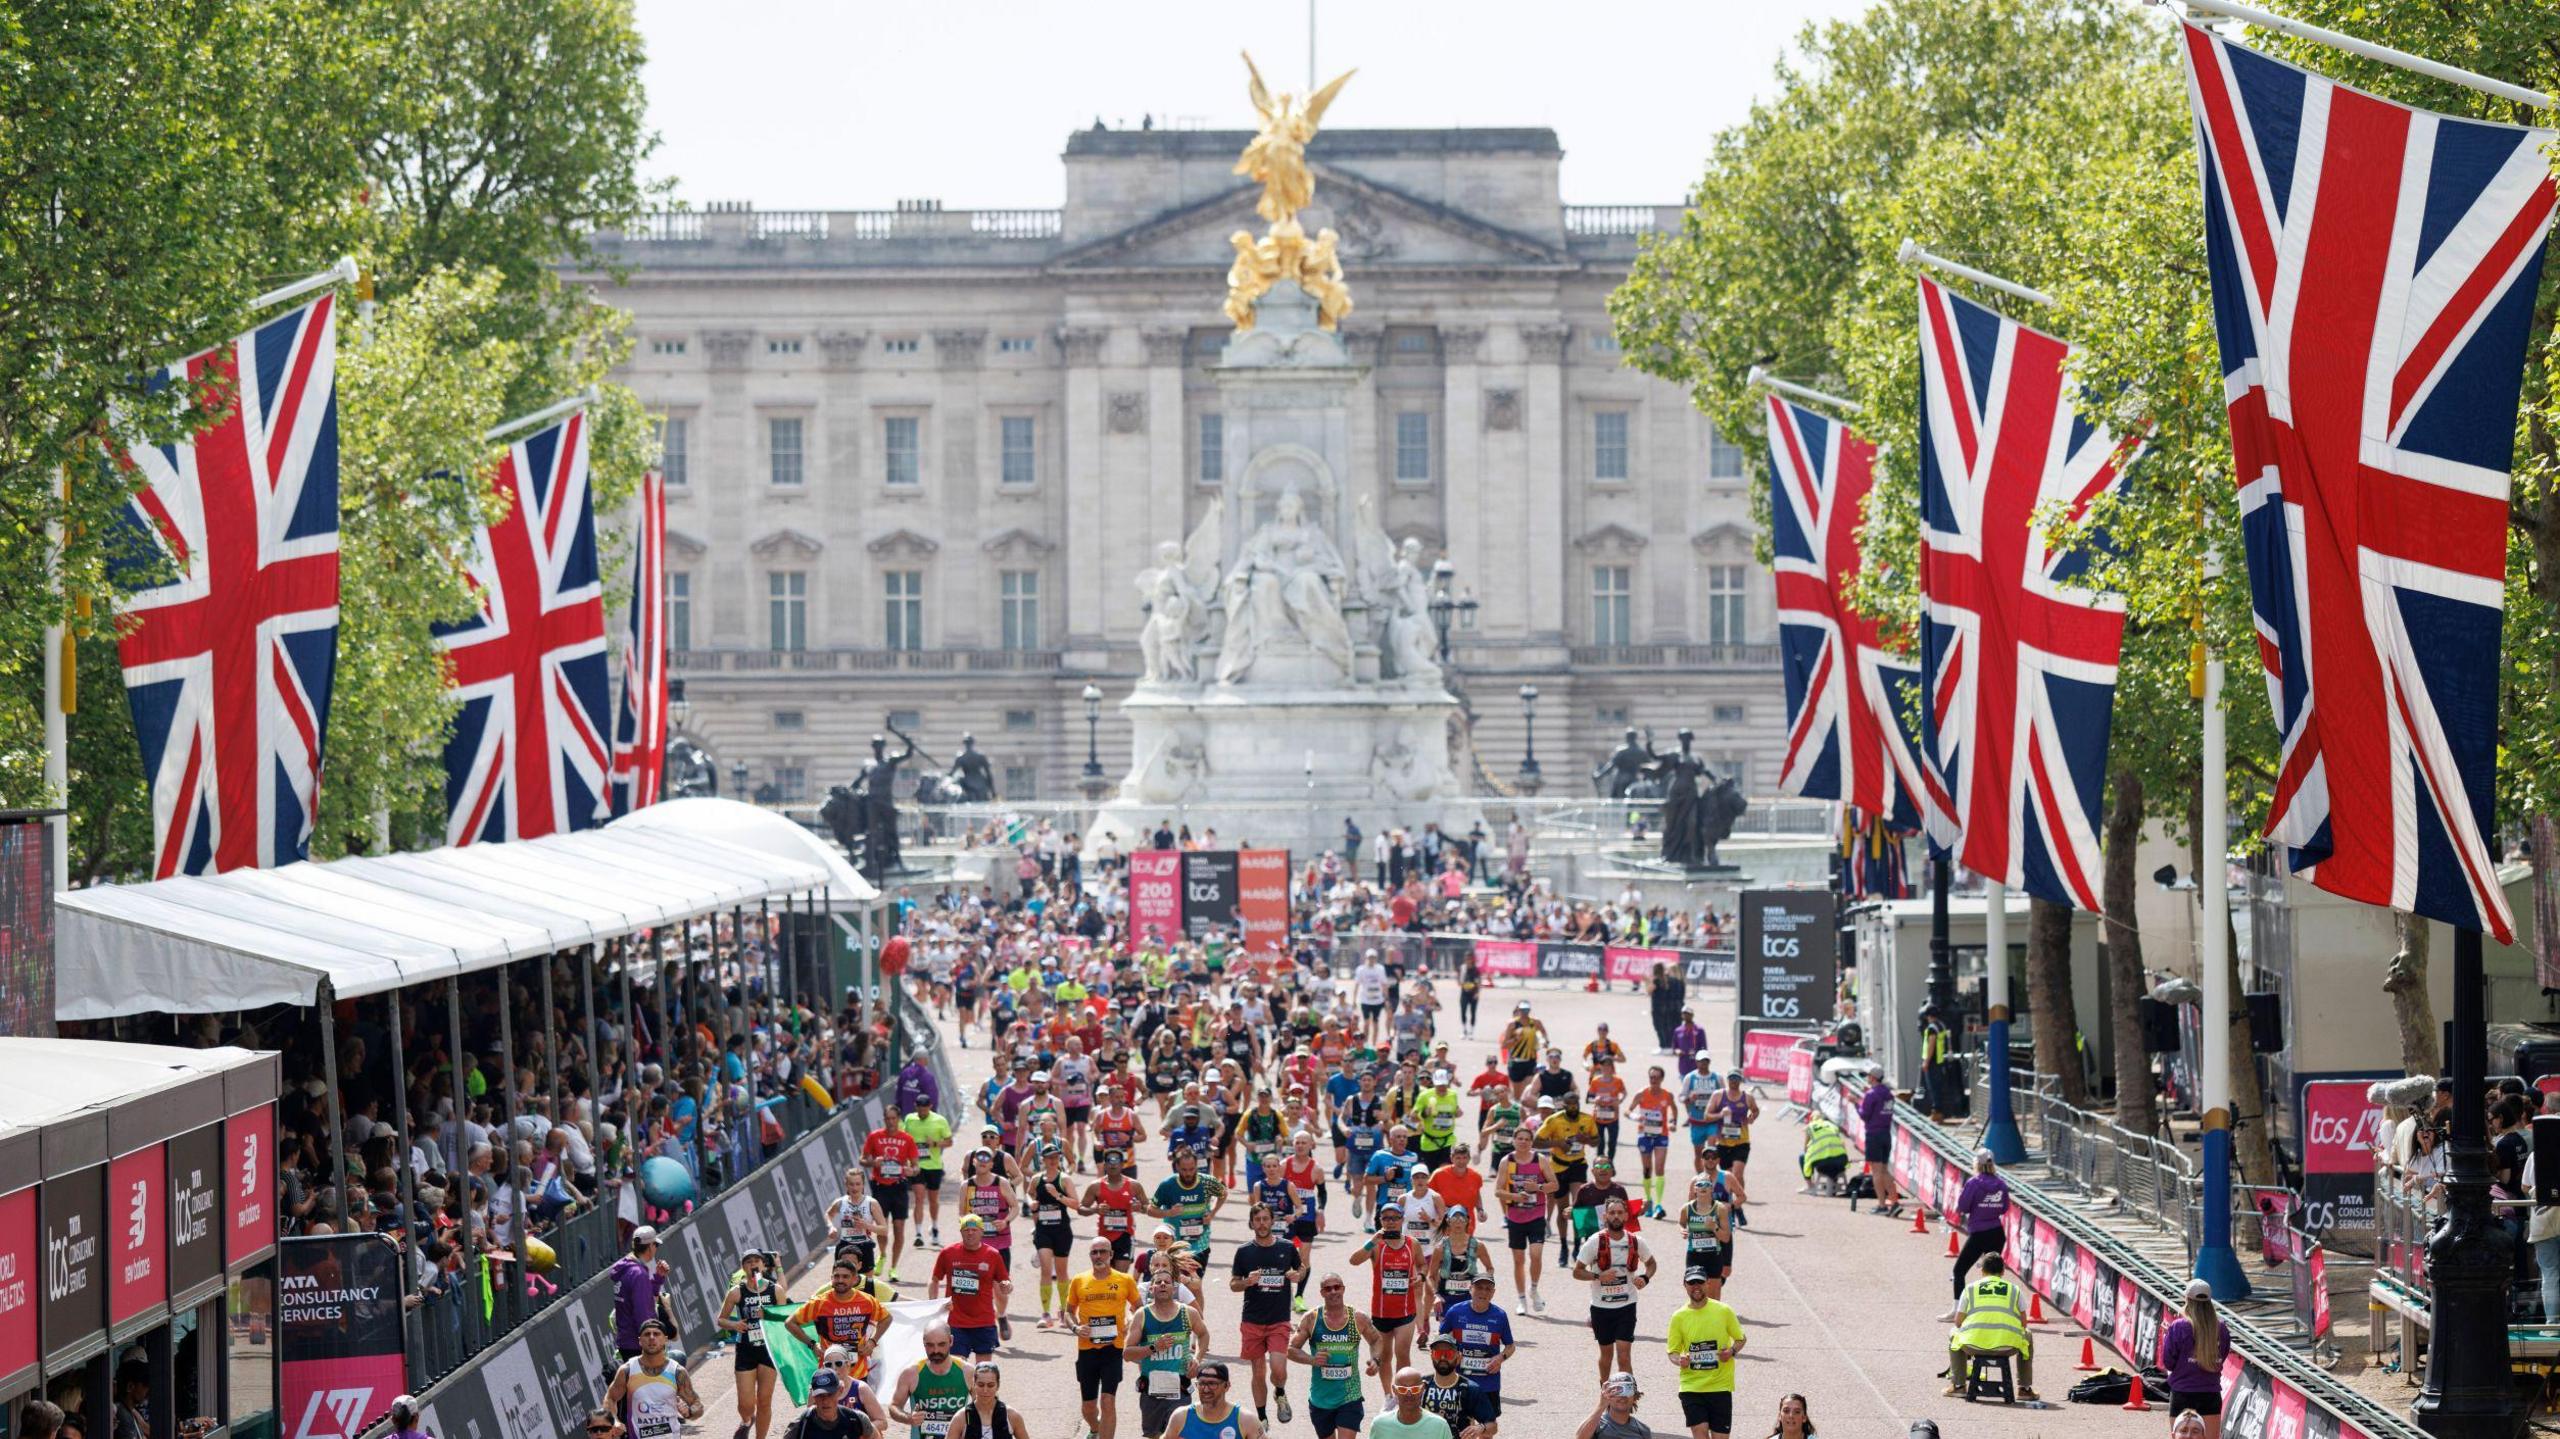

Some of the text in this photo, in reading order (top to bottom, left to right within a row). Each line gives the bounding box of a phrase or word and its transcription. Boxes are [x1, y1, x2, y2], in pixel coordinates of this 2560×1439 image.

[1138, 882, 1172, 898] 200
[1188, 881, 1220, 902] tcs
[1763, 906, 1786, 915] TATA
[1763, 915, 1815, 924] CONSULTANCY
[1763, 924, 1797, 932] SERVICES
[1763, 934, 1799, 958] tcs
[1763, 967, 1786, 975] TATA
[1763, 975, 1815, 983] CONSULTANCY
[1763, 983, 1797, 991] SERVICES
[1763, 993, 1799, 1018] tcs
[2310, 1110, 2349, 1144] tcs
[2338, 1195, 2363, 1205] TATA
[175, 1178, 192, 1247] tcs
[2305, 1202, 2334, 1230] cs
[2338, 1207, 2376, 1217] CONSULT
[2338, 1219, 2376, 1230] SERVICES
[69, 1235, 95, 1265] CONSULTANCY
[0, 1253, 15, 1281] ORLD
[50, 1225, 68, 1301] tcs
[69, 1267, 86, 1294] SERVICES
[0, 1280, 25, 1313] THLETICS
[281, 1306, 342, 1322] ERVICES
[834, 1306, 861, 1316] ADAM
[834, 1316, 866, 1324] CHILDREN
[1322, 1334, 1348, 1342] SHAUN
[1465, 1360, 1487, 1368] 44275
[919, 1397, 965, 1409] NSPCC
